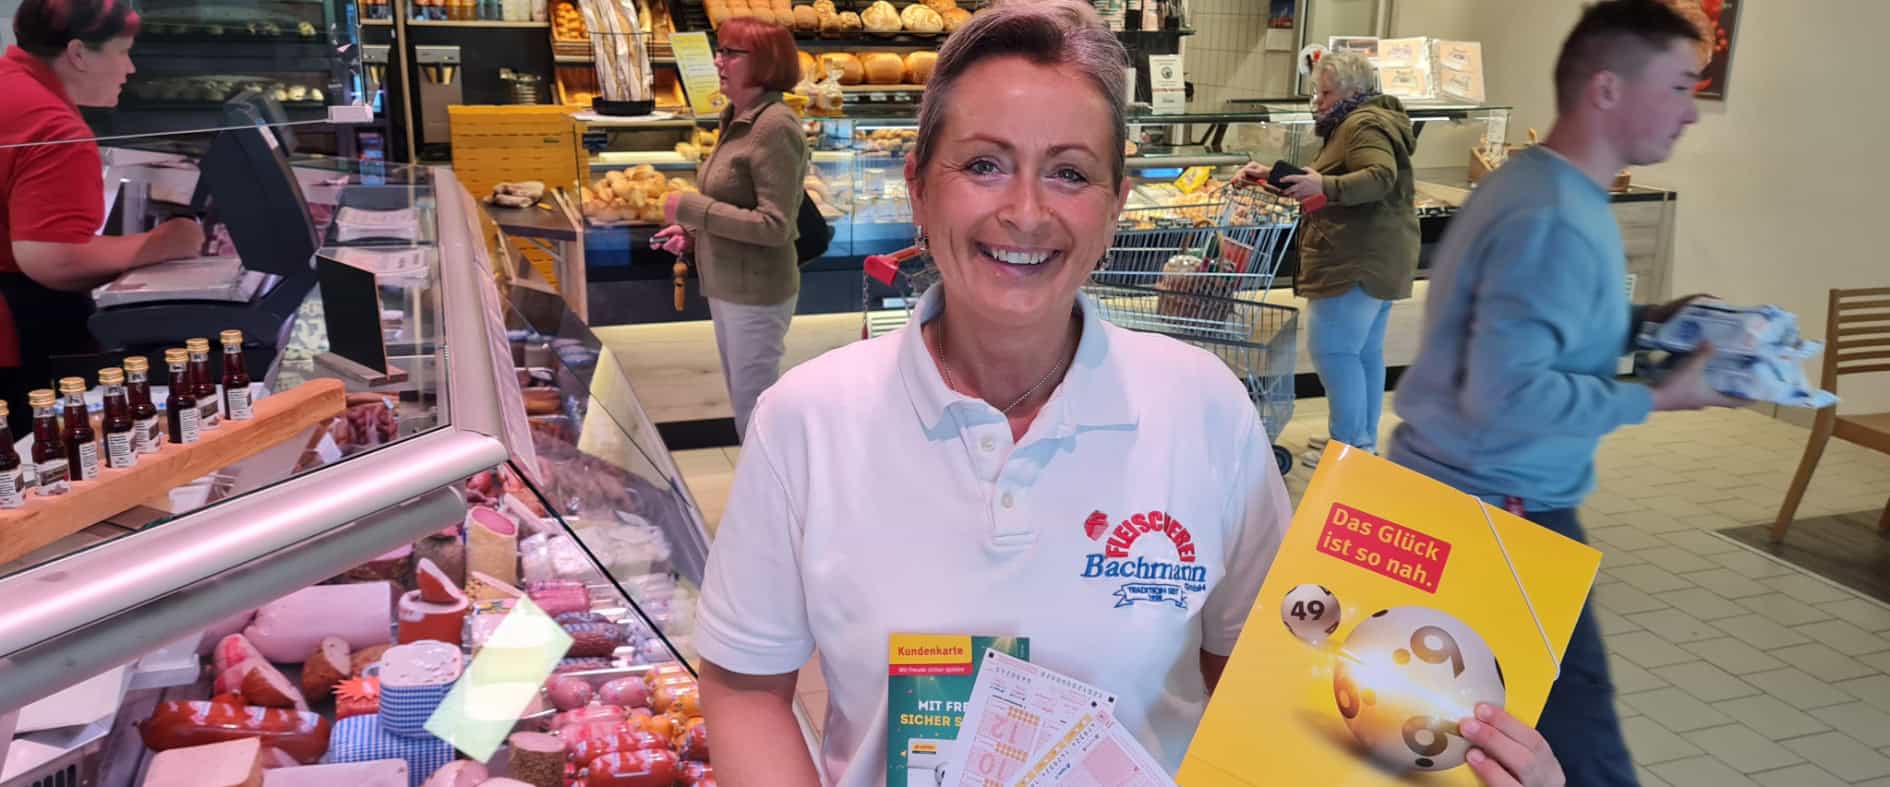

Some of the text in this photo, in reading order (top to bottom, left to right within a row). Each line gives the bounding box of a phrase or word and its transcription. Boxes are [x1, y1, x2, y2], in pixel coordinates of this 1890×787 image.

[1332, 508, 1440, 561] Das Glück
[1080, 554, 1207, 582] Bachmann
[1323, 530, 1432, 587] ist so nah.
[1290, 600, 1325, 621] 49
[897, 645, 964, 657] Kundenkarte
[918, 700, 942, 711] MIT
[900, 713, 952, 727] SICHER
